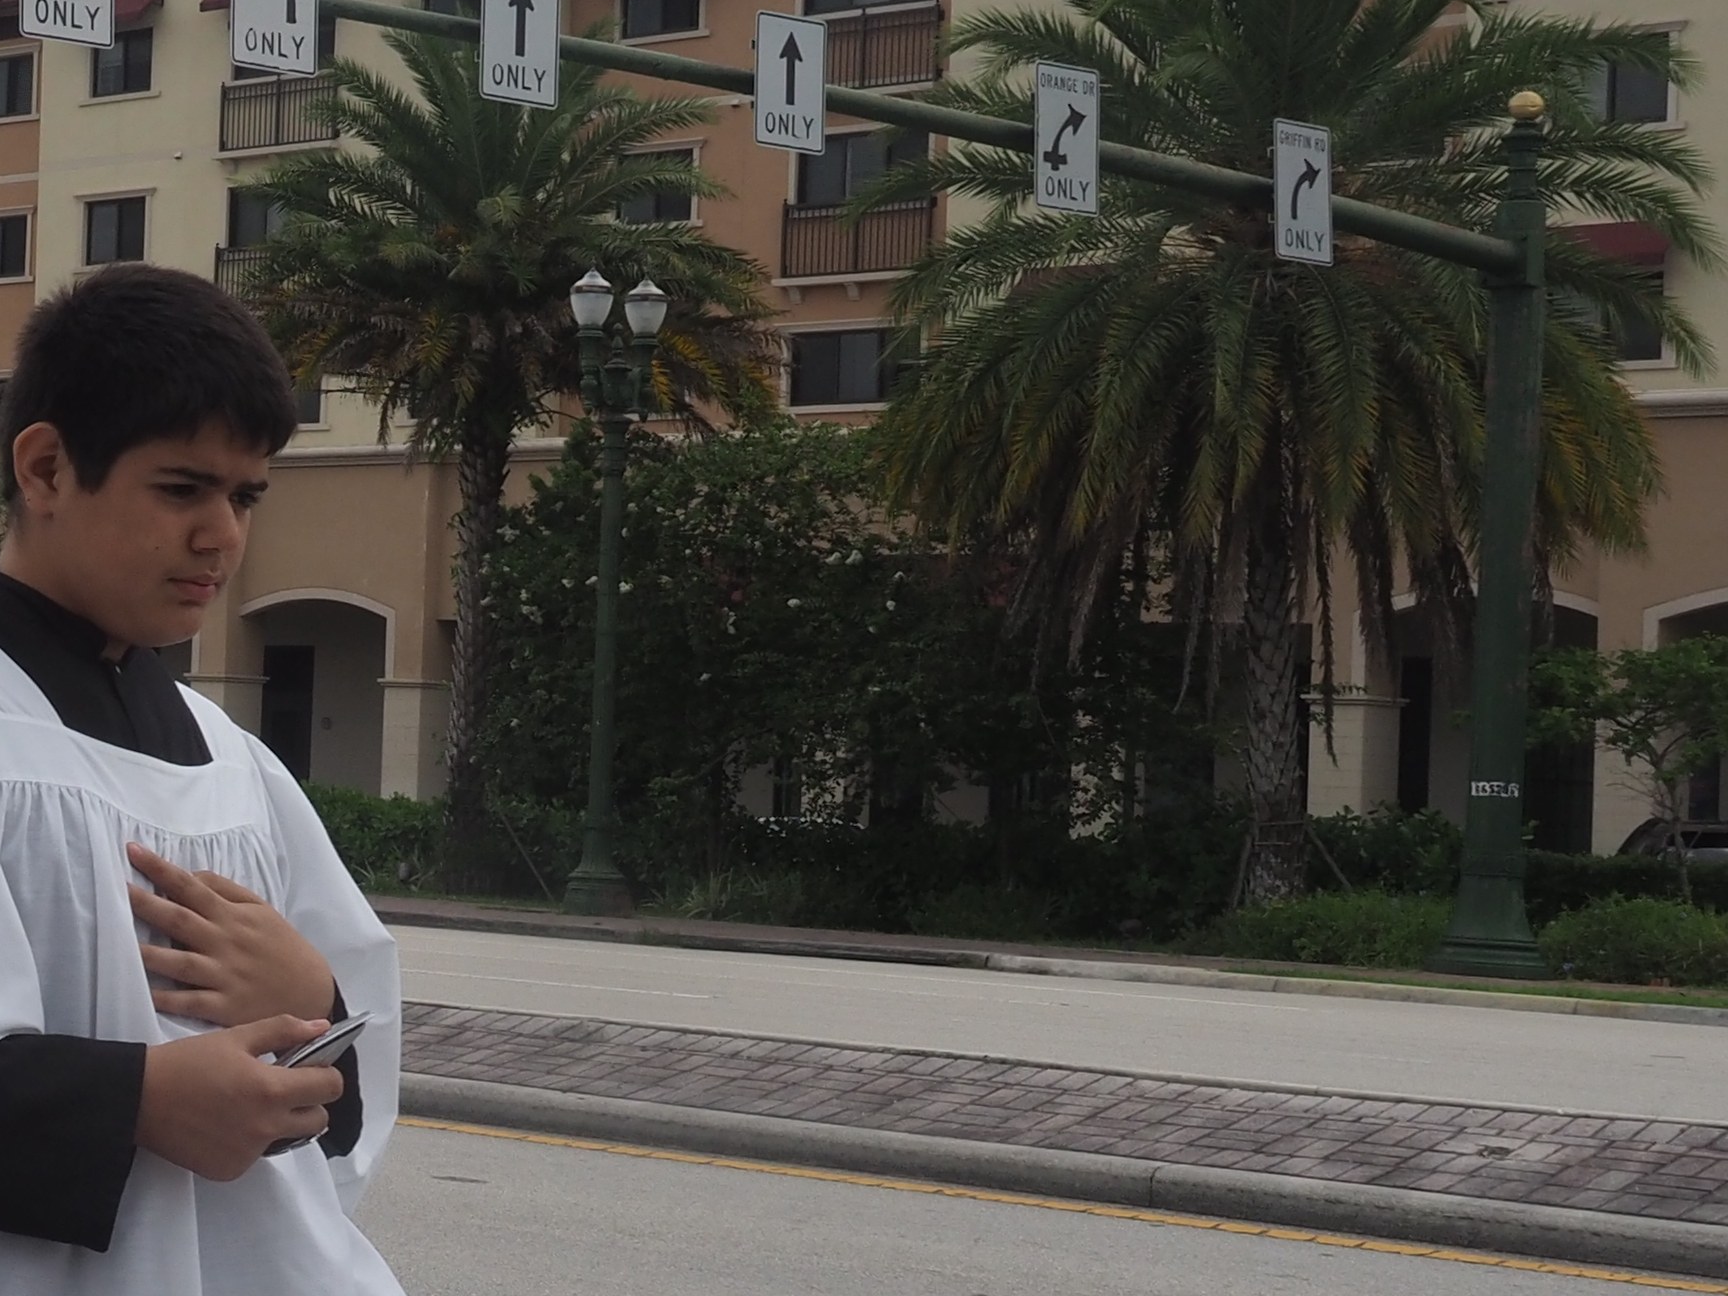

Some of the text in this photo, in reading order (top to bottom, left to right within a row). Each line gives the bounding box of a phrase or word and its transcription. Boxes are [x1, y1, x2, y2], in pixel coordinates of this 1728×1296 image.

[245, 27, 305, 60] ONLY
[492, 63, 546, 93] ONLY
[1040, 72, 1096, 97] ORANGE DR
[765, 111, 815, 139] ONLY
[1279, 130, 1326, 152] GRIFFIN RD
[1045, 175, 1091, 203] ONLY
[1285, 227, 1324, 252] ONLY
